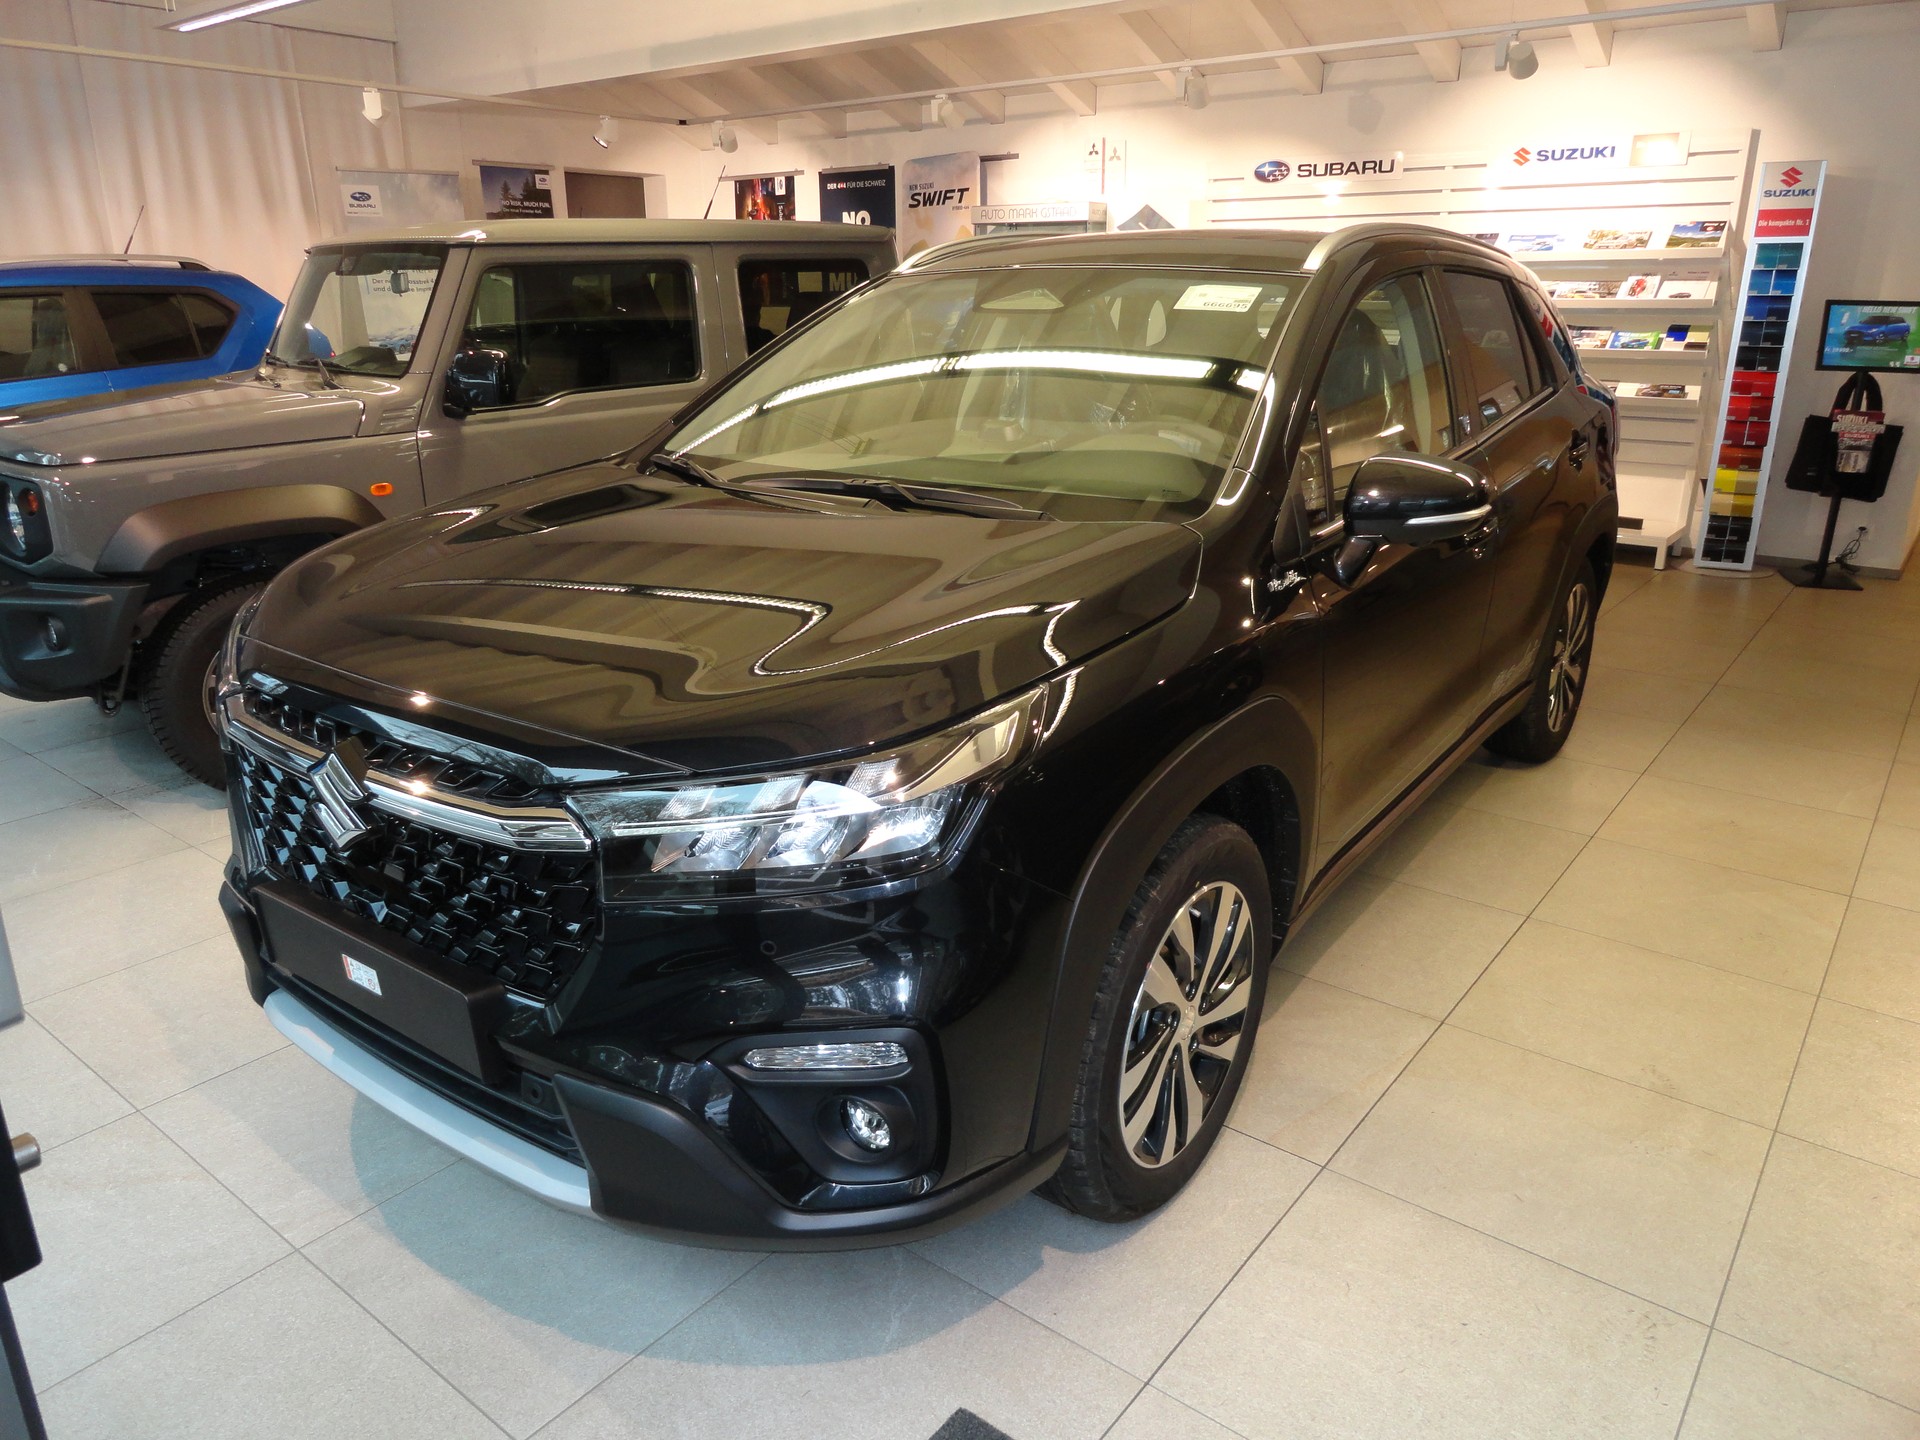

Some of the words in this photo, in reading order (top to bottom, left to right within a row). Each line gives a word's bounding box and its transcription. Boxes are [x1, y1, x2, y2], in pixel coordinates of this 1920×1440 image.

[1536, 146, 1616, 162] SUZUKI
[1297, 159, 1395, 178] SUBARU
[865, 179, 886, 187] SCHWEIZ
[919, 182, 935, 190] SUZUKI
[908, 187, 970, 208] SWIFT
[1763, 189, 1815, 197] SUZUKI
[842, 210, 871, 225] NO
[980, 210, 1006, 220] AUTO
[1008, 207, 1038, 219] MARK
[1040, 206, 1077, 217] GSTAAD
[1758, 219, 1768, 227] Die
[1769, 219, 1795, 227] kompakte
